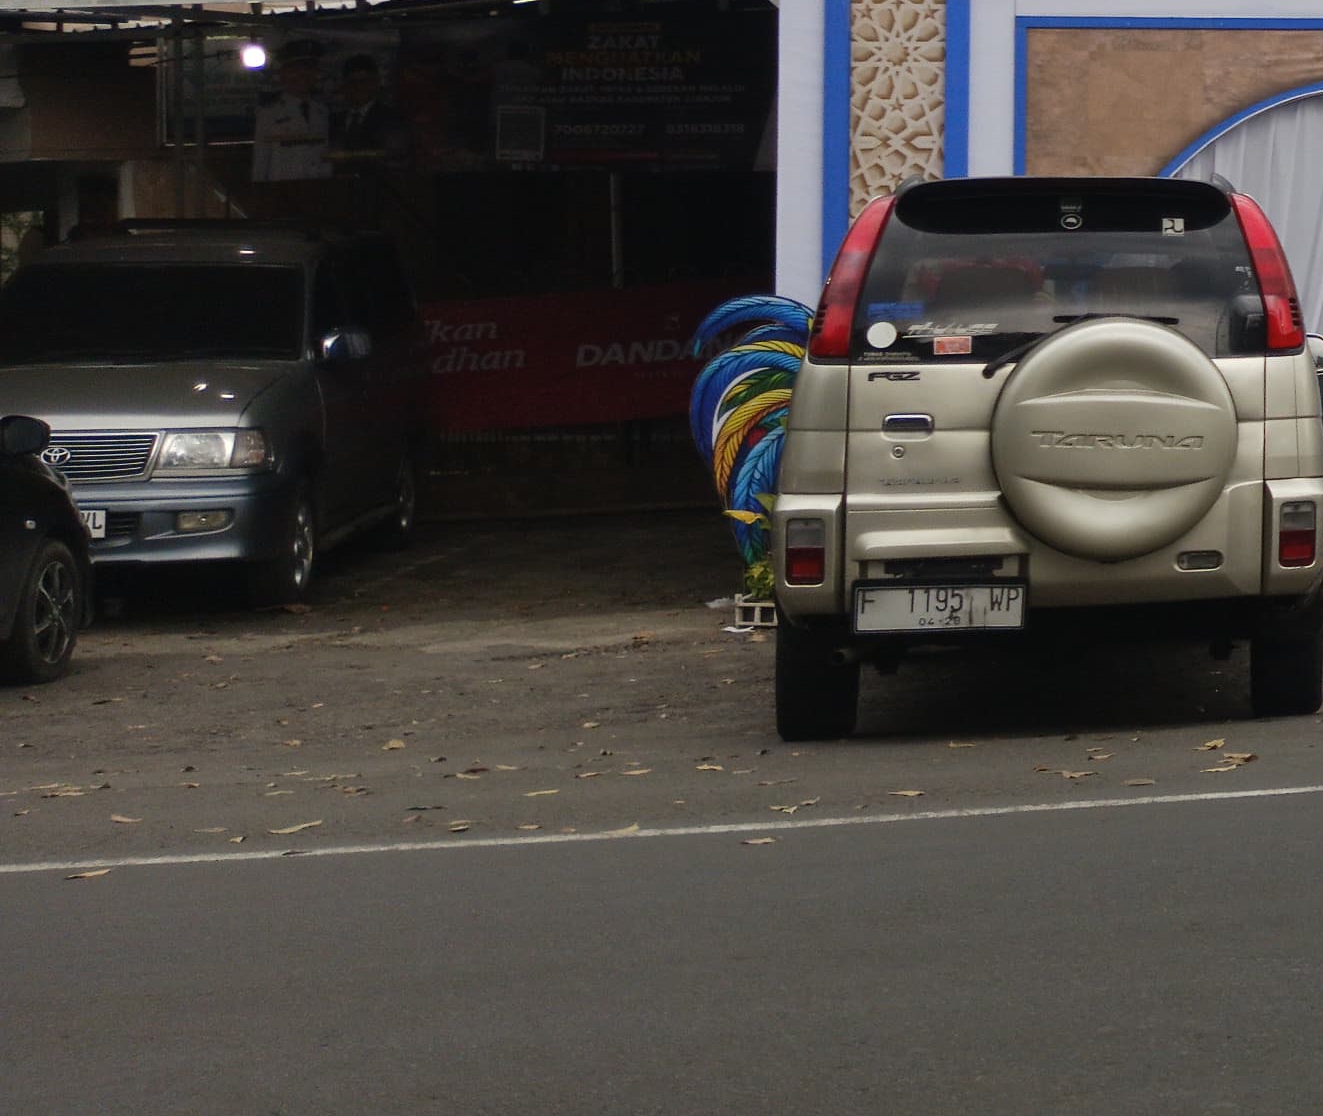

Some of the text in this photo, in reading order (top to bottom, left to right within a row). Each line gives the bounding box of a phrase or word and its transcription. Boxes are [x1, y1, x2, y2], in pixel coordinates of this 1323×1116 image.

[562, 67, 684, 82] INDONESIA
[1031, 430, 1205, 452] TARUNA
[860, 587, 1020, 614] F 1195 WP
